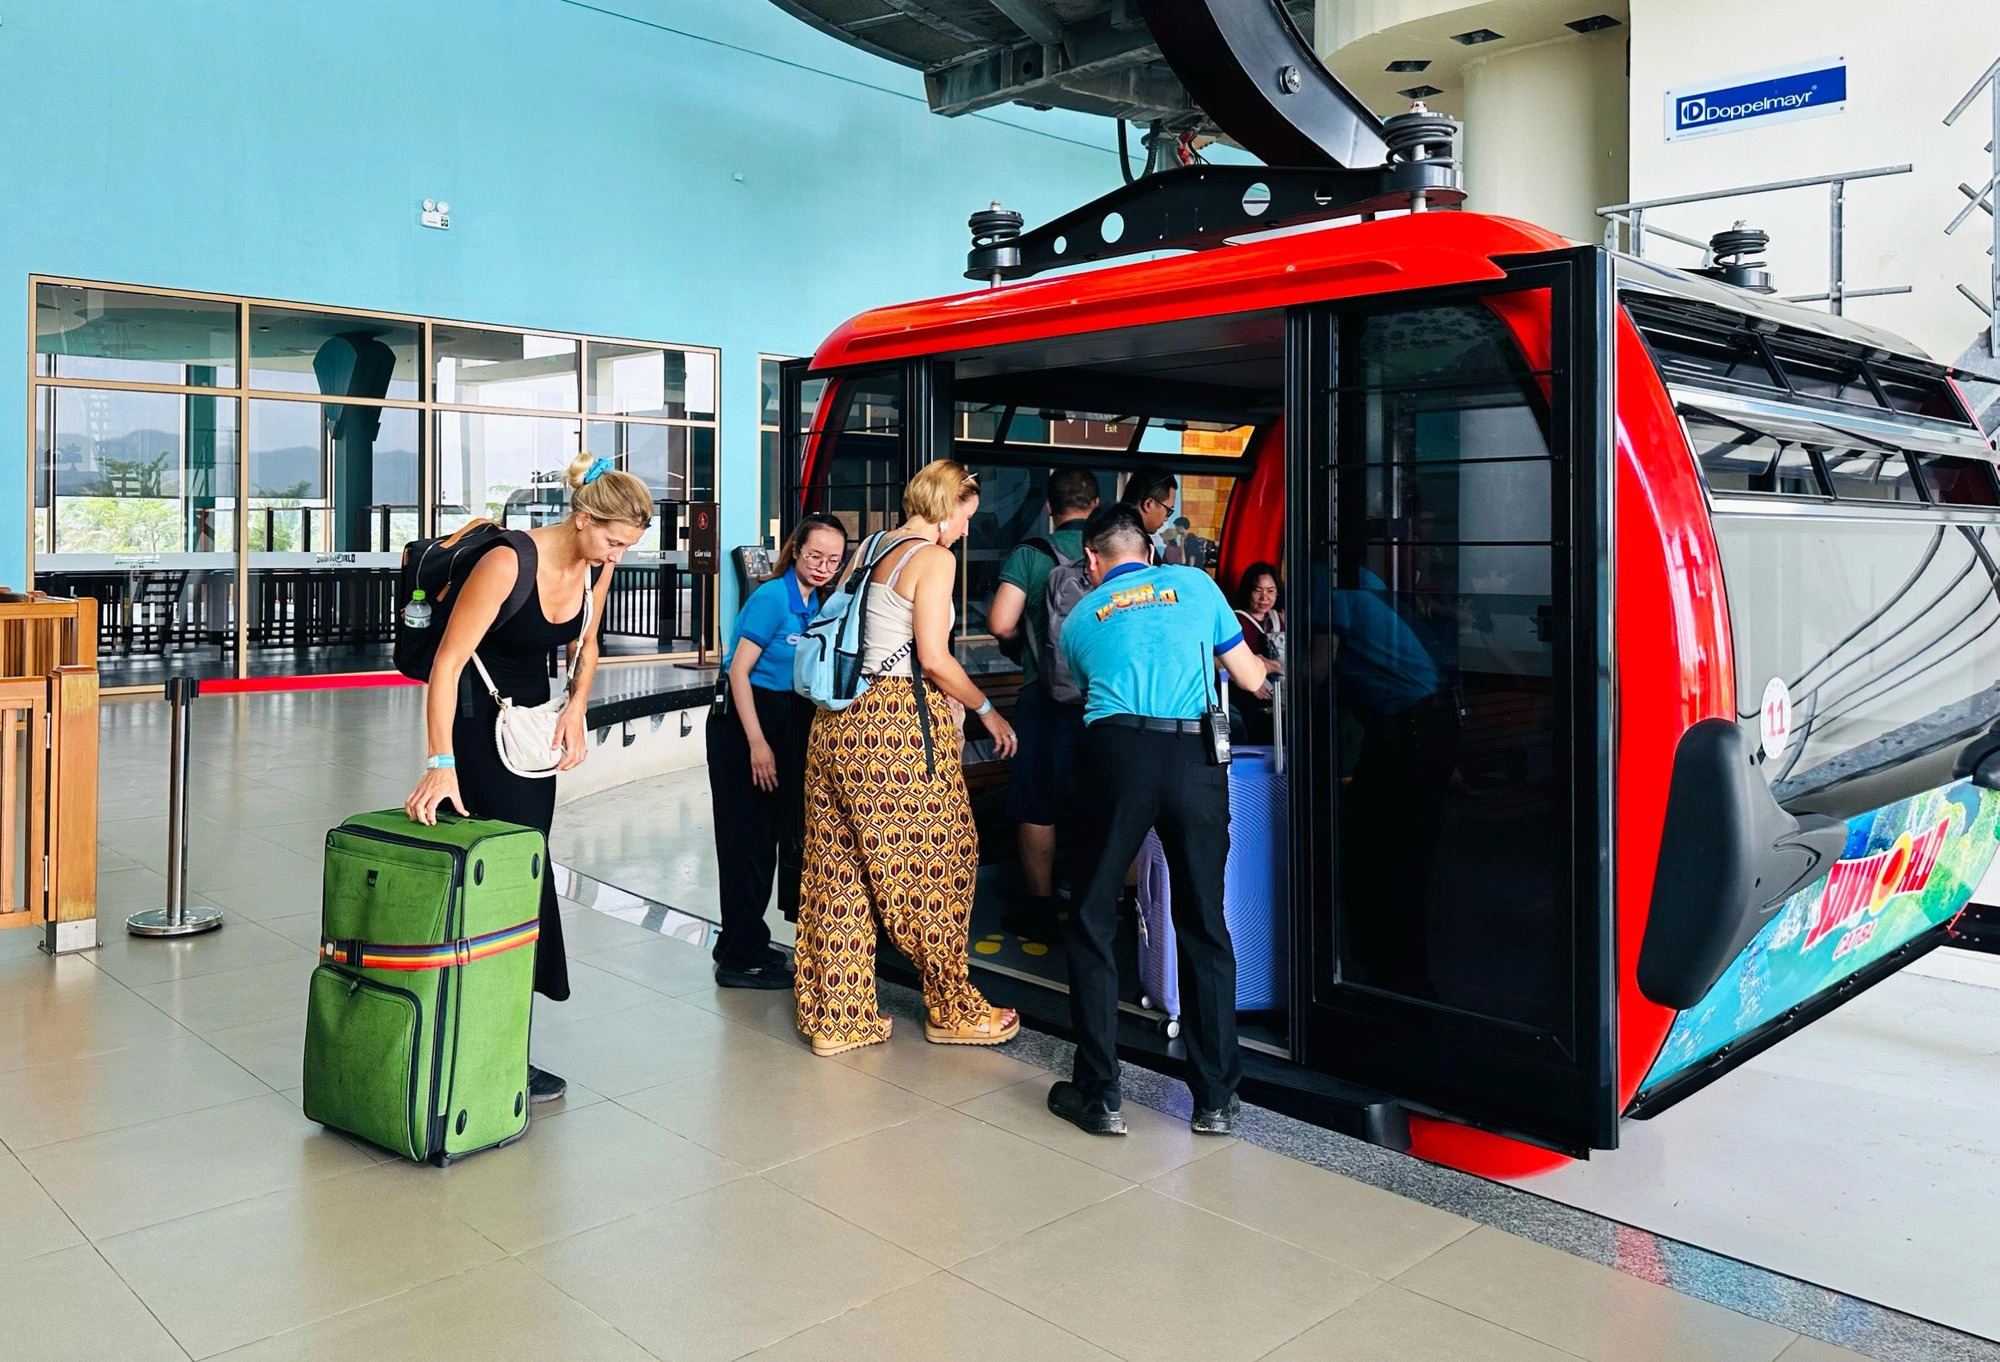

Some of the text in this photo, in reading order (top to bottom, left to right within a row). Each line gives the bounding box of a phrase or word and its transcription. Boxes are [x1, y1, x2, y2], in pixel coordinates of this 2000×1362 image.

[1706, 91, 1813, 120] Doppelmayr
[1104, 424, 1117, 433] Exit
[1096, 589, 1179, 622] WORLD
[1110, 583, 1156, 600] SUN
[1767, 699, 1785, 737] 11
